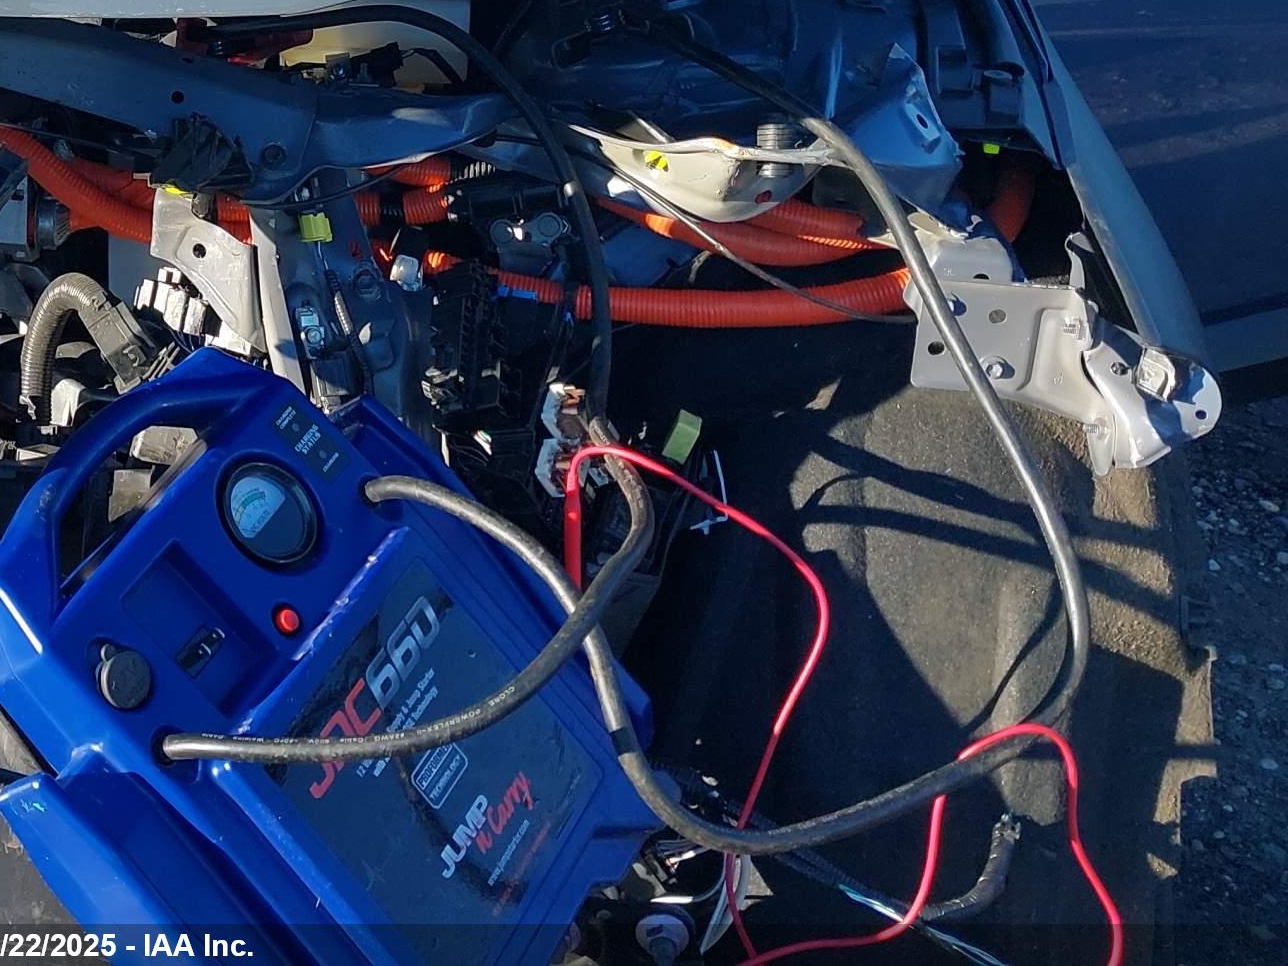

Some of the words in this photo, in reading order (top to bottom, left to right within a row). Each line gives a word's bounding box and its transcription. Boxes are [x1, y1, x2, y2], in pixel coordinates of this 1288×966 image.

[294, 424, 319, 452] CHARGING
[302, 432, 320, 455] STATUS
[416, 665, 435, 691] Starter
[430, 754, 460, 800] TECHNOLOGY
[491, 771, 533, 835] Carry
[440, 794, 488, 878] JUMP
